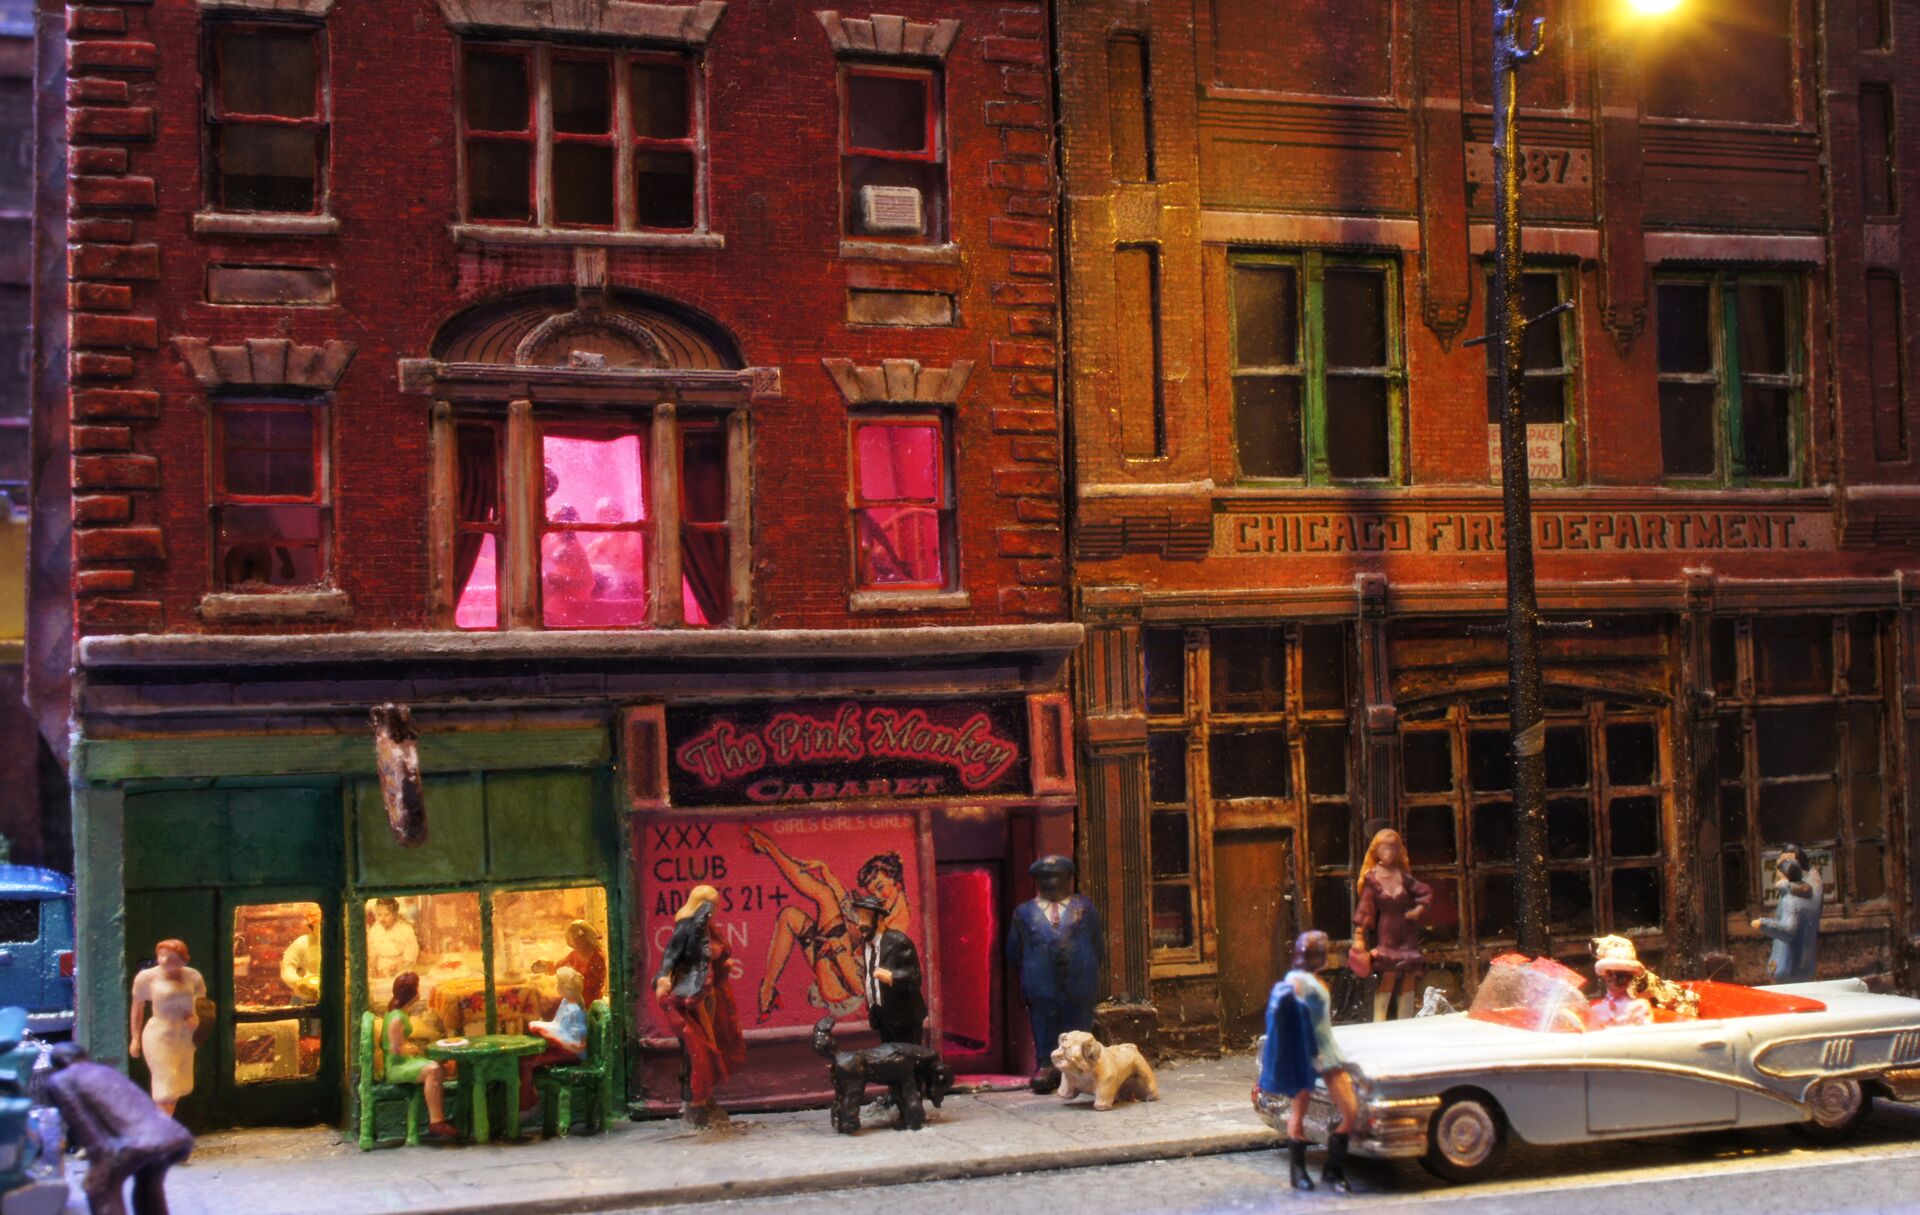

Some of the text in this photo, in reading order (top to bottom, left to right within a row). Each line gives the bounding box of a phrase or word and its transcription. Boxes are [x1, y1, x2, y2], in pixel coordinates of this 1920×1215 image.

[1488, 150, 1570, 185] 87
[1528, 428, 1556, 441] PACE
[1528, 446, 1550, 459] ASE
[1233, 515, 1412, 552] CHICAGO
[684, 706, 1013, 783] The Pink Monkey
[747, 778, 943, 801] CABARET
[654, 823, 714, 850] XXX
[774, 813, 913, 834] GIRLS GIRLS GIRLS
[653, 855, 727, 883] CLUB
[655, 886, 734, 916] ADS
[655, 921, 749, 951] ON
